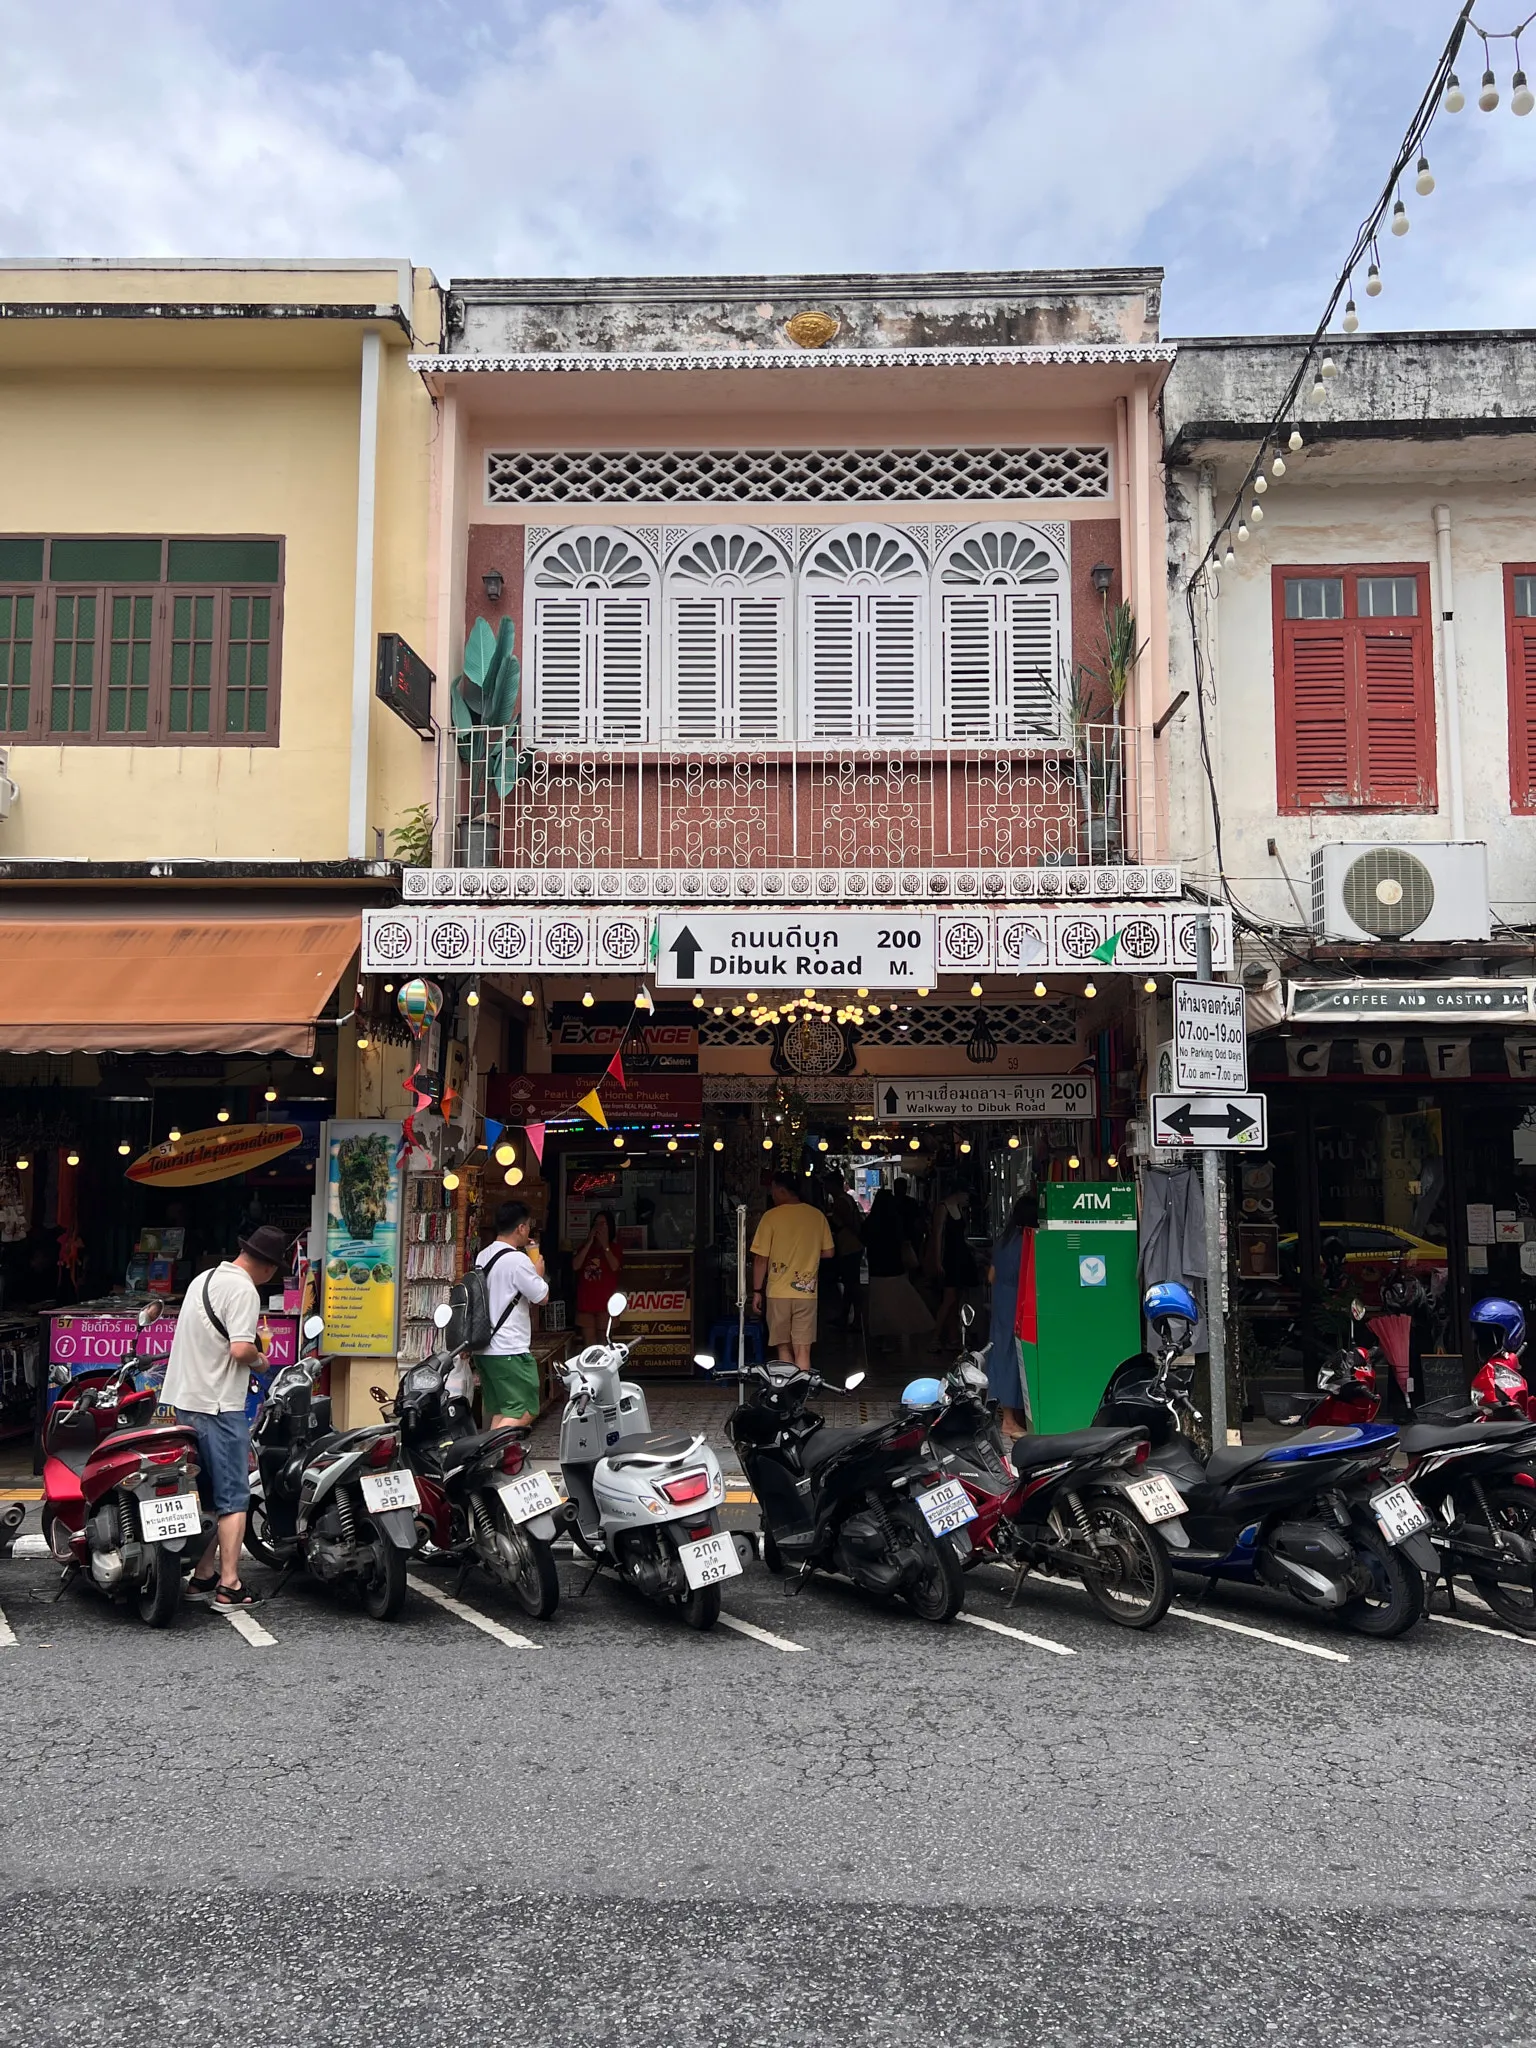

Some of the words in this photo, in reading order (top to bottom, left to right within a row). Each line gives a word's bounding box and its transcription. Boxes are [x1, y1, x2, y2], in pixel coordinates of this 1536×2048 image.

[730, 924, 838, 954] ถนนดีบุก
[877, 930, 921, 949] 200
[709, 955, 787, 975] Dibuk
[796, 955, 862, 975] Road
[889, 960, 914, 975] M.
[1333, 995, 1388, 1005] COFFEE
[1399, 995, 1426, 1005] AND
[1437, 995, 1491, 1005] GASTRO
[1503, 994, 1528, 1005] BAR
[559, 1022, 692, 1045] EXCHNGE
[1179, 1020, 1242, 1044] 07.00-19.00
[1180, 1047, 1188, 1057] No
[1191, 1047, 1213, 1060] Parking
[1215, 1049, 1226, 1059] Odd
[1228, 1050, 1241, 1062] Days
[1008, 1057, 1019, 1070] 59
[1180, 1063, 1196, 1079] 7.00
[1233, 1074, 1243, 1083] pm
[544, 1089, 568, 1099] Pearl
[572, 1089, 603, 1100] Los
[605, 1089, 633, 1099] Home
[636, 1089, 670, 1100] Phuket
[1051, 1083, 1087, 1099] 200
[906, 1103, 957, 1114] Walkway
[962, 1104, 973, 1113] to
[978, 1102, 1011, 1113] Dibuk
[1015, 1102, 1046, 1112] Road
[1065, 1102, 1076, 1112] M
[148, 1151, 197, 1173] Tourist
[199, 1131, 285, 1163] Information
[160, 1143, 173, 1156] 57
[1072, 1193, 1111, 1210] ATM
[57, 1318, 73, 1329] 57
[381, 1494, 406, 1508] 287
[520, 1497, 553, 1517] 1469
[1154, 1502, 1177, 1517] 439
[938, 1508, 969, 1531] 2871
[1396, 1514, 1422, 1536] 8193
[158, 1522, 187, 1537] 362
[701, 1563, 727, 1582] 837
